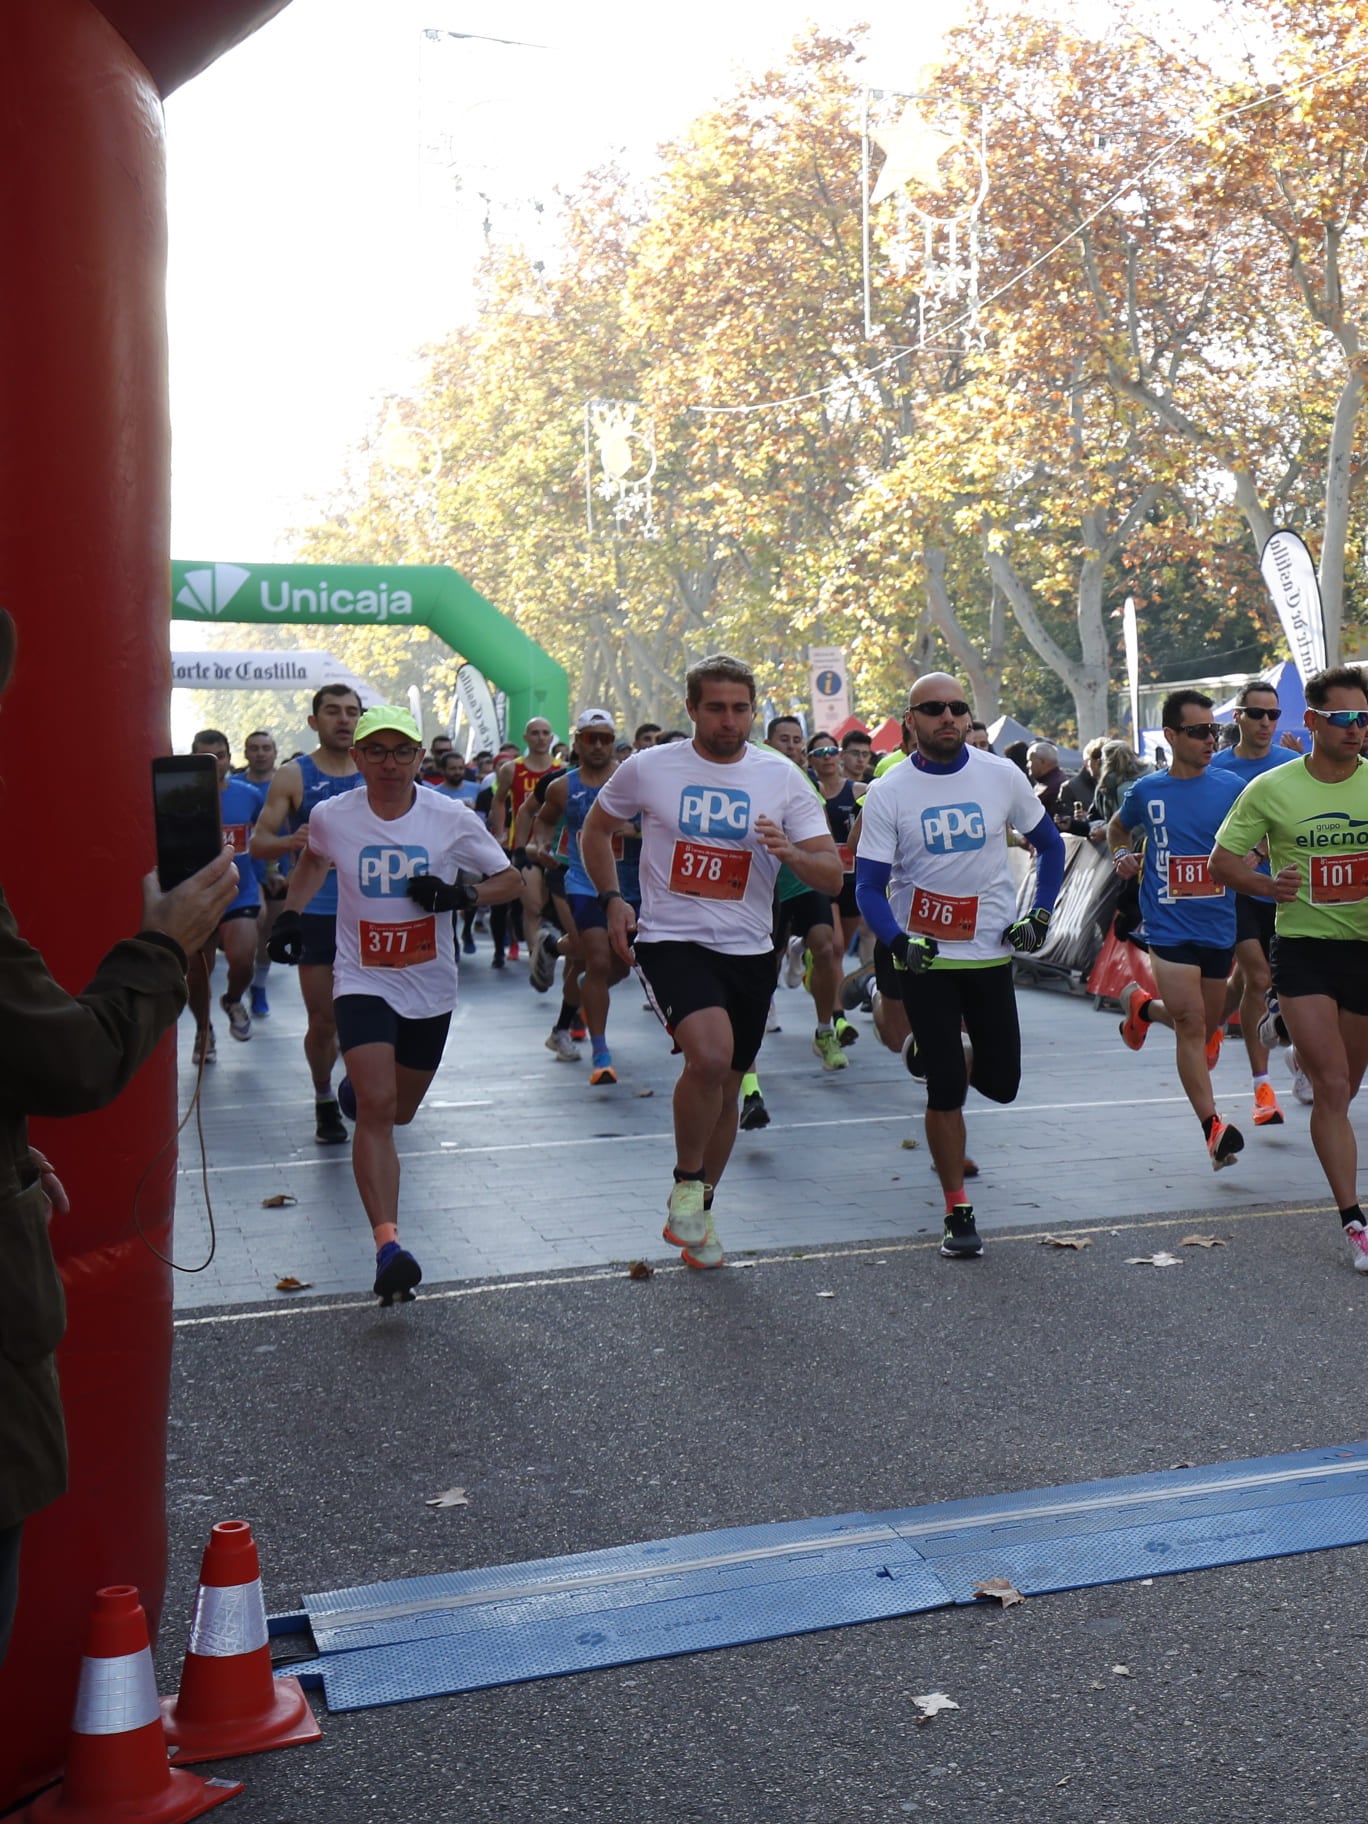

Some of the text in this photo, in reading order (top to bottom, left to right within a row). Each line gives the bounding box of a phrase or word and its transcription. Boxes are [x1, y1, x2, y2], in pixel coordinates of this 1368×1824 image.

[260, 580, 413, 621] Unicaja
[214, 662, 233, 680] de
[235, 661, 307, 681] Castilla
[682, 790, 748, 833] PPG
[923, 808, 984, 850] PPG
[1316, 823, 1341, 832] grupo
[681, 853, 722, 881] 378
[1176, 864, 1203, 883] 181
[1320, 864, 1353, 886] 101
[918, 898, 953, 925] 376
[368, 931, 408, 952] 377
